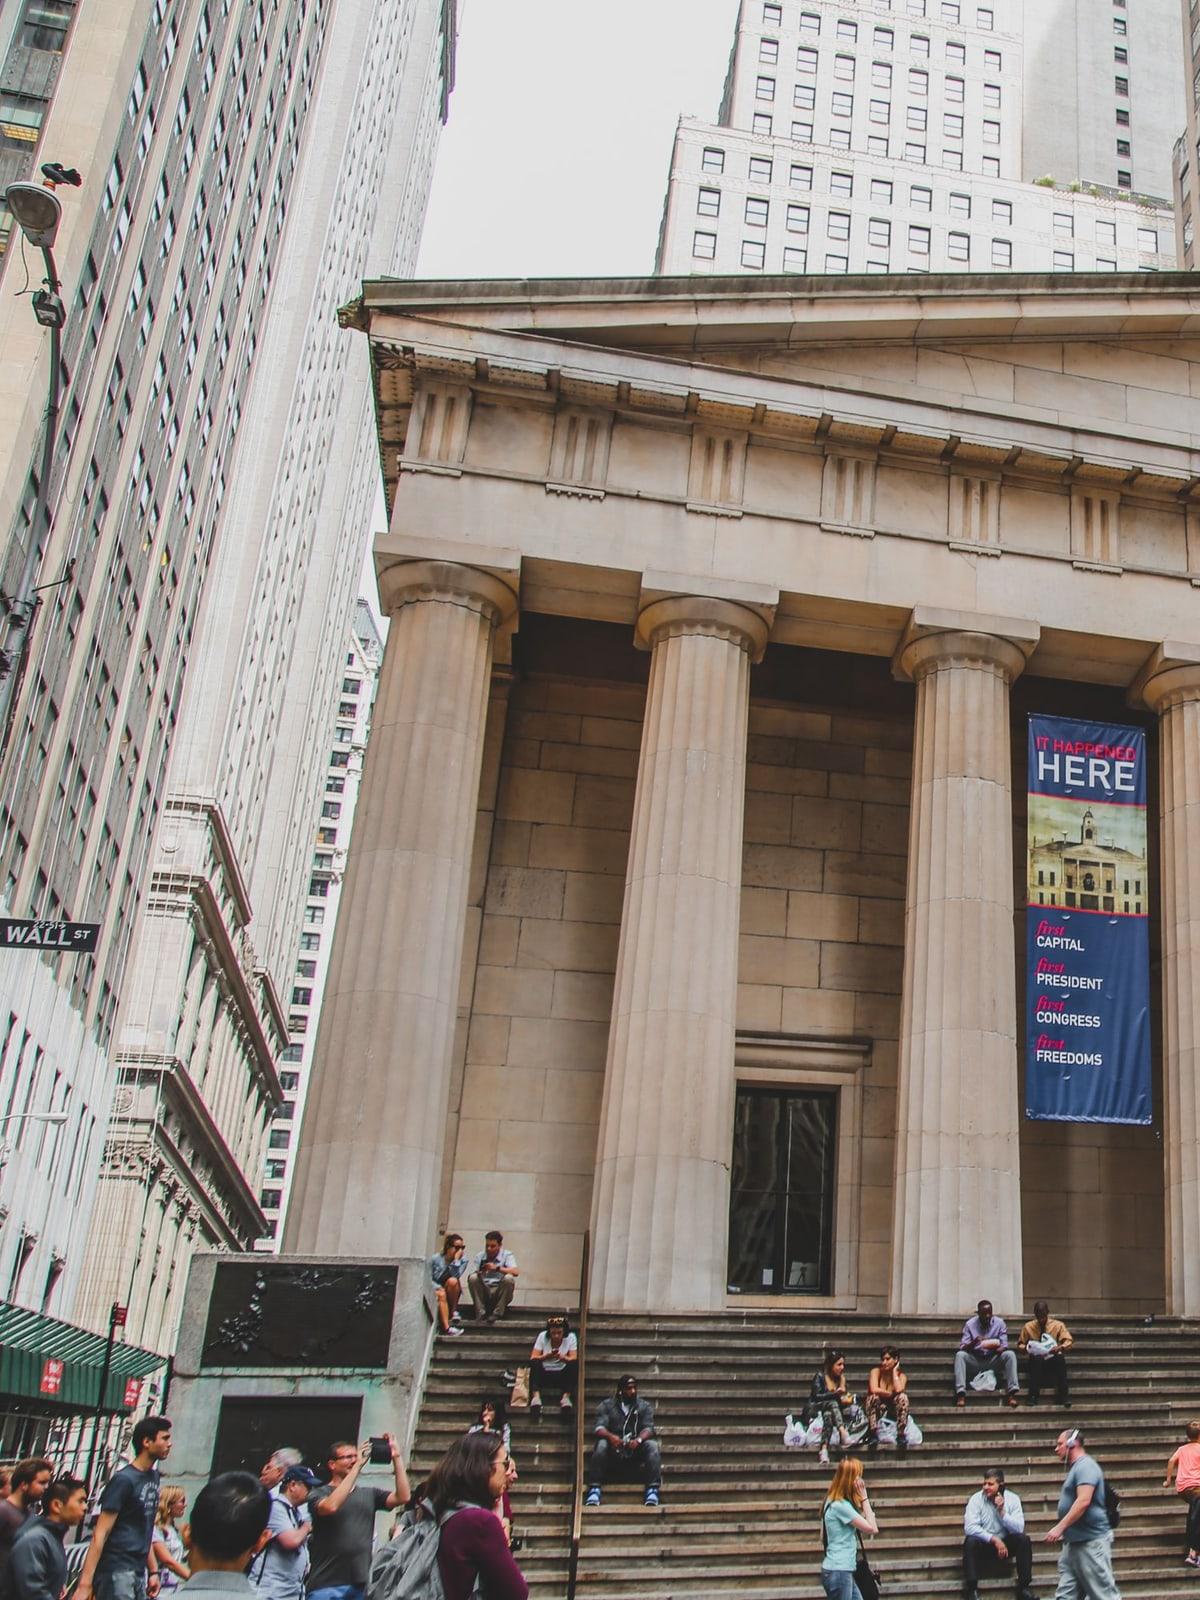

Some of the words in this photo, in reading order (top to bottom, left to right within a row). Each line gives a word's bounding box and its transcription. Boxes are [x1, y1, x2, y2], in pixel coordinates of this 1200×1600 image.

[1036, 737, 1049, 750] IT
[1053, 740, 1136, 760] HAPPENED
[1038, 752, 1136, 792] HERE
[6, 925, 72, 946] WALL
[74, 930, 91, 940] ST
[1035, 920, 1065, 936] first
[1036, 936, 1085, 951] CAPITAL
[1035, 957, 1065, 973] first
[1036, 973, 1103, 990] PRESIDENT
[1035, 995, 1065, 1011] first
[1036, 1011, 1101, 1027] CONGRESS
[1035, 1033, 1065, 1049] first
[1036, 1050, 1103, 1066] FREEDOMS
